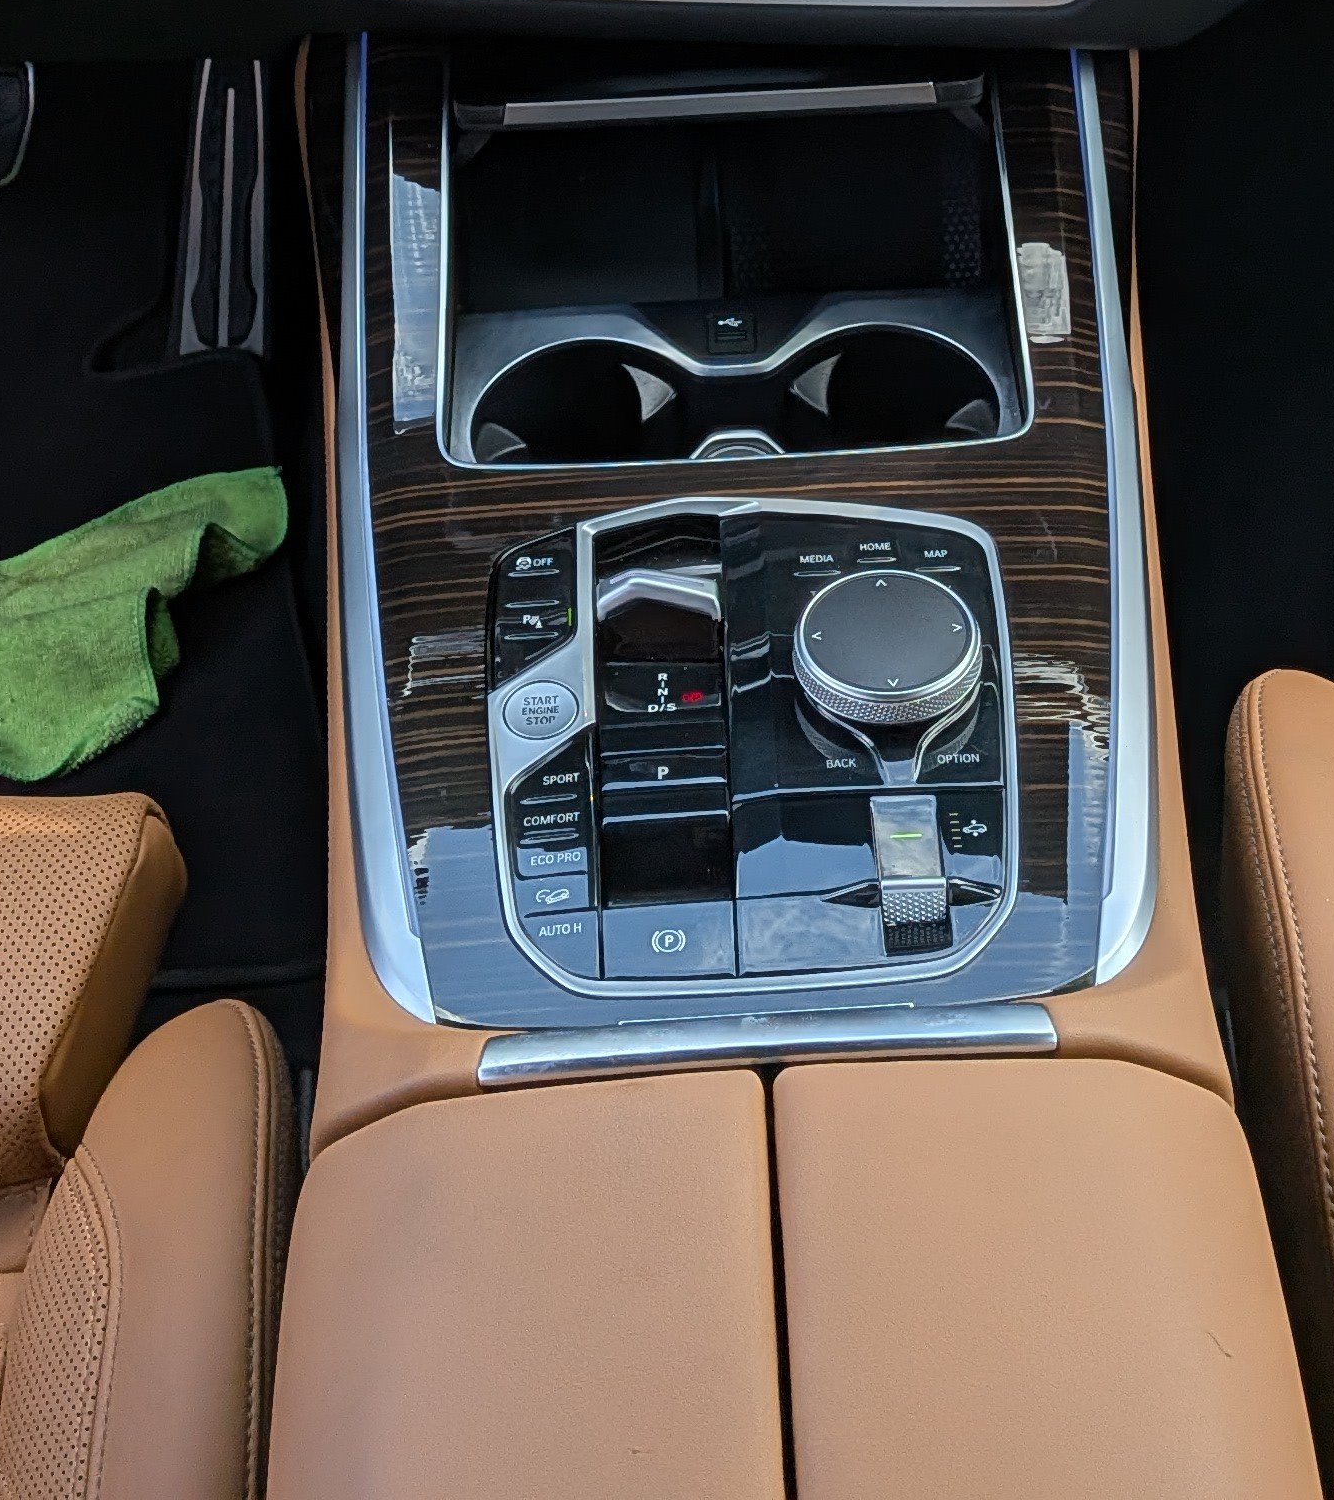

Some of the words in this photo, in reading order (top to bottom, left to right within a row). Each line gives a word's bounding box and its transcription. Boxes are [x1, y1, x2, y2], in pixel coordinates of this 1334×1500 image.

[858, 542, 892, 552] HOME
[799, 554, 835, 564] MEDIA
[923, 549, 948, 559] MAP
[532, 557, 554, 568] OFF
[523, 694, 560, 706] START
[521, 705, 560, 716] ENGINE
[525, 715, 556, 726] STOP
[825, 758, 857, 770] BACK
[936, 752, 981, 765] OPTION
[542, 772, 581, 786] SPORT
[657, 766, 670, 781] P
[523, 811, 581, 827] COMFORT
[530, 853, 555, 866] ECO
[556, 850, 582, 865] PRO
[538, 923, 571, 937] AUTO
[573, 922, 582, 935] H
